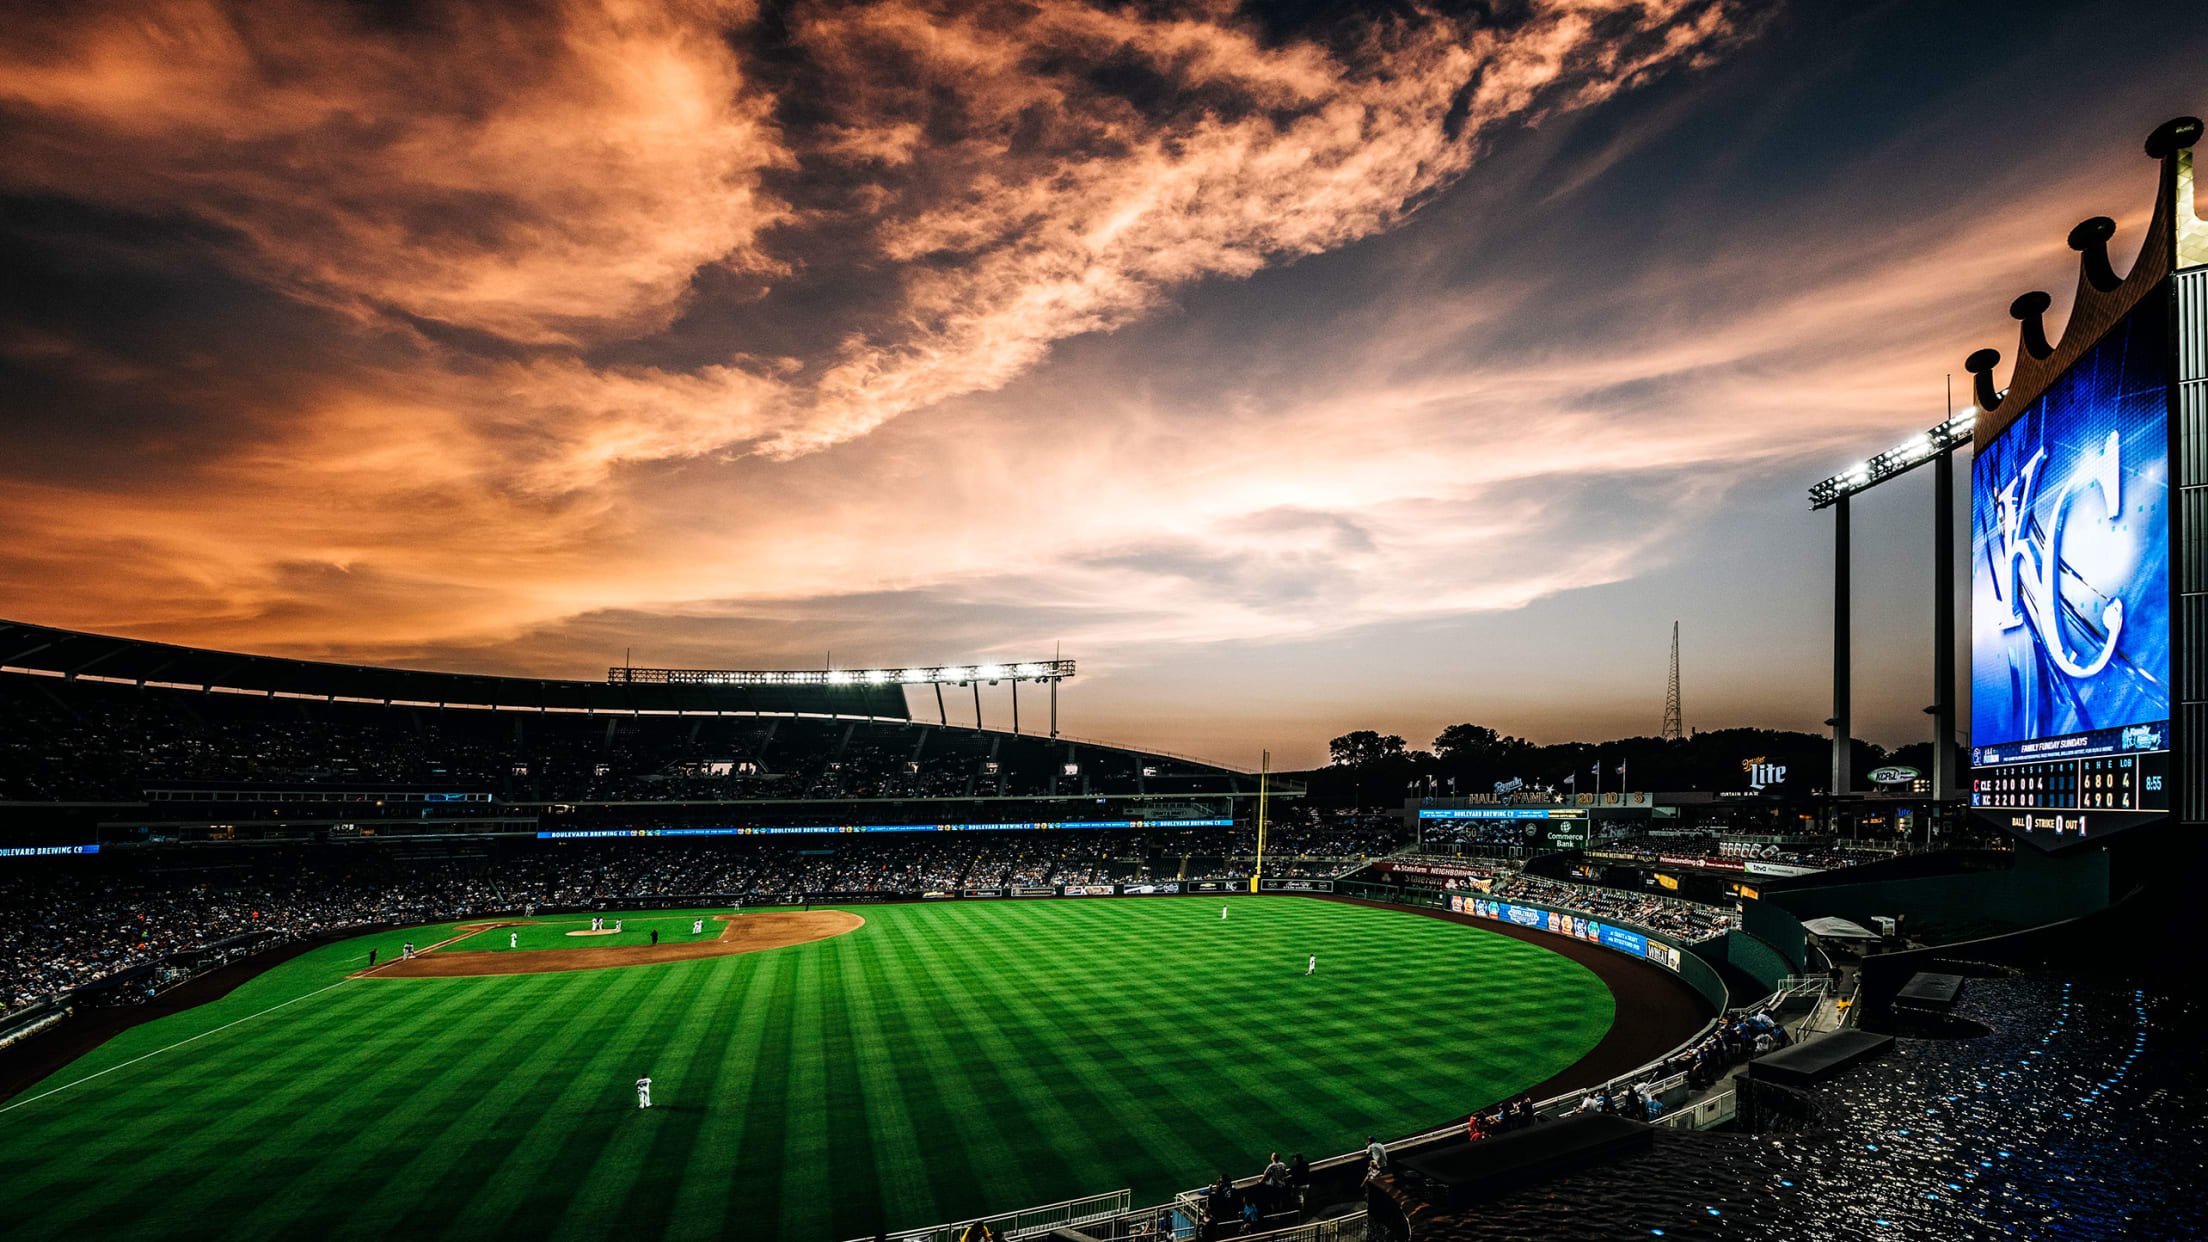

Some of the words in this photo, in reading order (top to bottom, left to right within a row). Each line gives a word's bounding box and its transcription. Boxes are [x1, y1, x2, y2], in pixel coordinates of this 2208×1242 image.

[1997, 430, 2123, 678] KC
[2021, 743, 2040, 753] FAMILY
[2039, 741, 2060, 751] FUNDAY
[2060, 737, 2088, 748] SUNDAYS
[1742, 756, 1766, 773] Miller
[2085, 762, 2089, 770] R
[2096, 761, 2101, 769] H
[2108, 760, 2112, 768] E
[2120, 759, 2132, 767] LOB
[1750, 763, 1786, 790] Lite
[1980, 780, 1991, 791] CLE
[1995, 780, 2000, 791] 2
[2002, 779, 2008, 791] 0
[2010, 779, 2015, 791] 0
[2020, 778, 2026, 790] 0
[2028, 778, 2034, 790] 0
[2037, 777, 2043, 790] 4
[2084, 775, 2090, 788] 6
[2095, 774, 2101, 788] 8
[2107, 774, 2113, 788] 0
[2122, 772, 2129, 788] 4
[2145, 775, 2162, 790] 8:55
[1494, 777, 1522, 795] Royals
[1469, 793, 1500, 804] HALL
[1513, 791, 1550, 804] FAME
[1578, 793, 1593, 804] 20
[1605, 792, 1617, 803] 10
[1982, 795, 1991, 806] KC
[1995, 795, 2000, 806] 2
[2002, 794, 2007, 806] 2
[2010, 794, 2015, 806] 0
[2020, 794, 2026, 806] 0
[2028, 794, 2034, 806] 0
[2084, 793, 2090, 807] 4
[2095, 793, 2101, 807] 9
[2106, 793, 2113, 807] 0
[2122, 793, 2129, 807] 4
[2012, 817, 2025, 826] BALL
[2026, 814, 2032, 831] 0
[2035, 818, 2055, 829] STRIKE
[2056, 815, 2063, 833] 0
[2065, 819, 2078, 830] OUT
[2079, 816, 2086, 834] 1
[1547, 832, 1583, 840] Commerce
[0, 847, 36, 856] OULEVARD
[37, 846, 72, 855] BREWING
[1660, 856, 1696, 866] PrimeLending
[1470, 880, 1491, 890] SONIC
[1648, 944, 1668, 964] WHEAT
